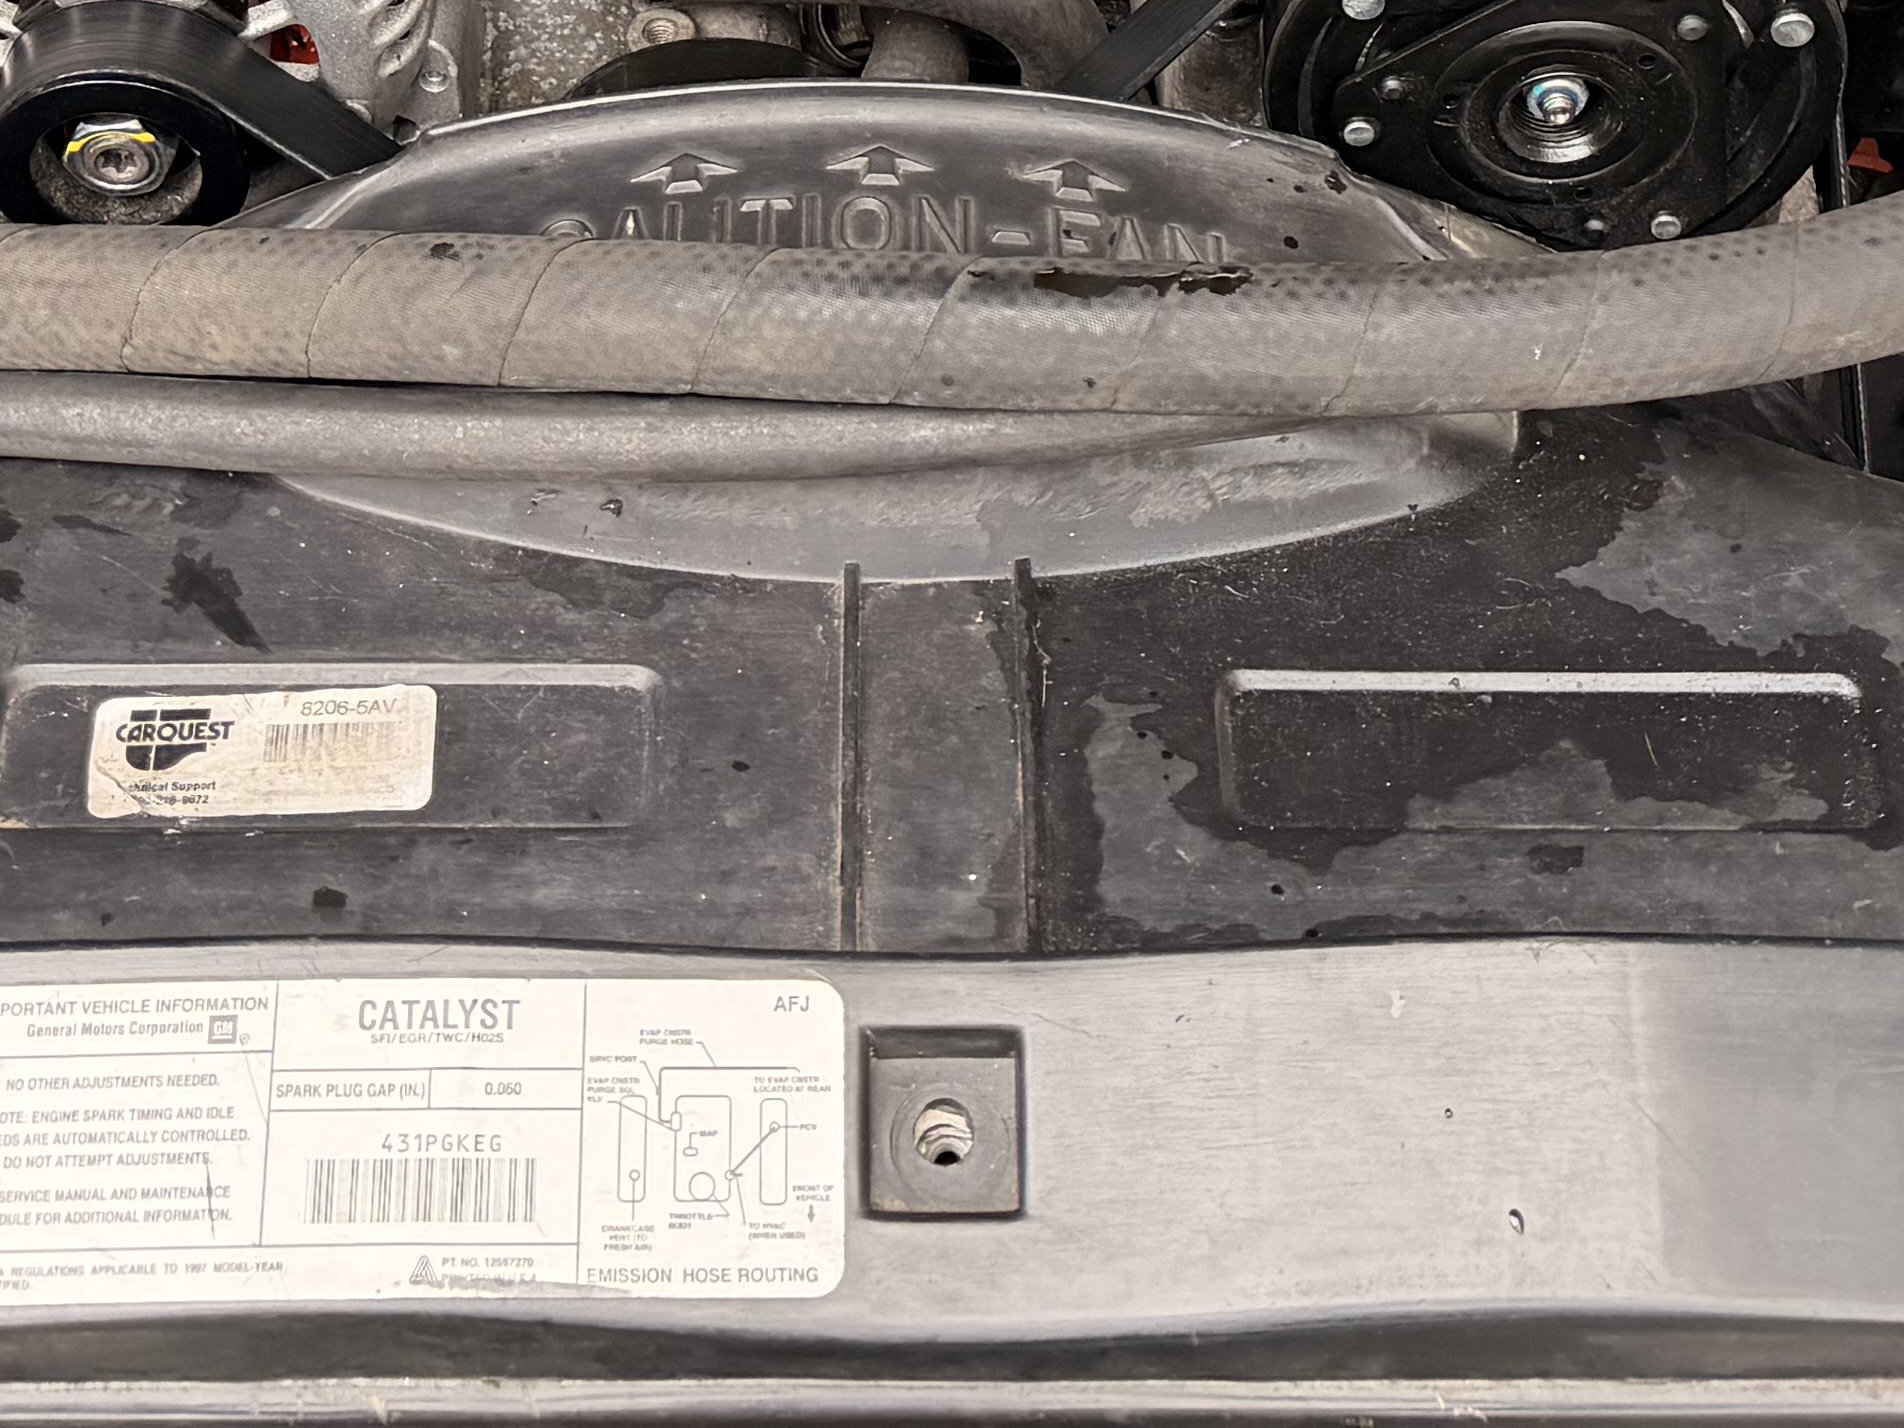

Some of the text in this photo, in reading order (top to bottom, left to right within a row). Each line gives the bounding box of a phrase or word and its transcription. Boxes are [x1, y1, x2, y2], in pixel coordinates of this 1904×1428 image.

[301, 698, 396, 716] 8206-5AV
[115, 720, 235, 743] CARQUEST
[171, 781, 216, 793] Support
[82, 999, 152, 1015] VEHICLE
[155, 996, 269, 1013] INFORMATION
[773, 996, 810, 1012] AFJ
[358, 998, 521, 1032] CATALYST
[26, 1020, 204, 1038] General Motors Corporation
[212, 1020, 234, 1036] GM
[6, 1073, 221, 1091] NO OTHER ADJUSTMENTS NEEDED.
[276, 1082, 426, 1100] SPARK PLUG GAP (IN.)
[484, 1082, 522, 1096] 0.060
[53, 1128, 252, 1146] AUTOMATICALLY CONTROLLED.
[382, 1134, 502, 1153] 431PGKEG
[587, 1267, 819, 1283] EMISSION HOSE ROUTING
